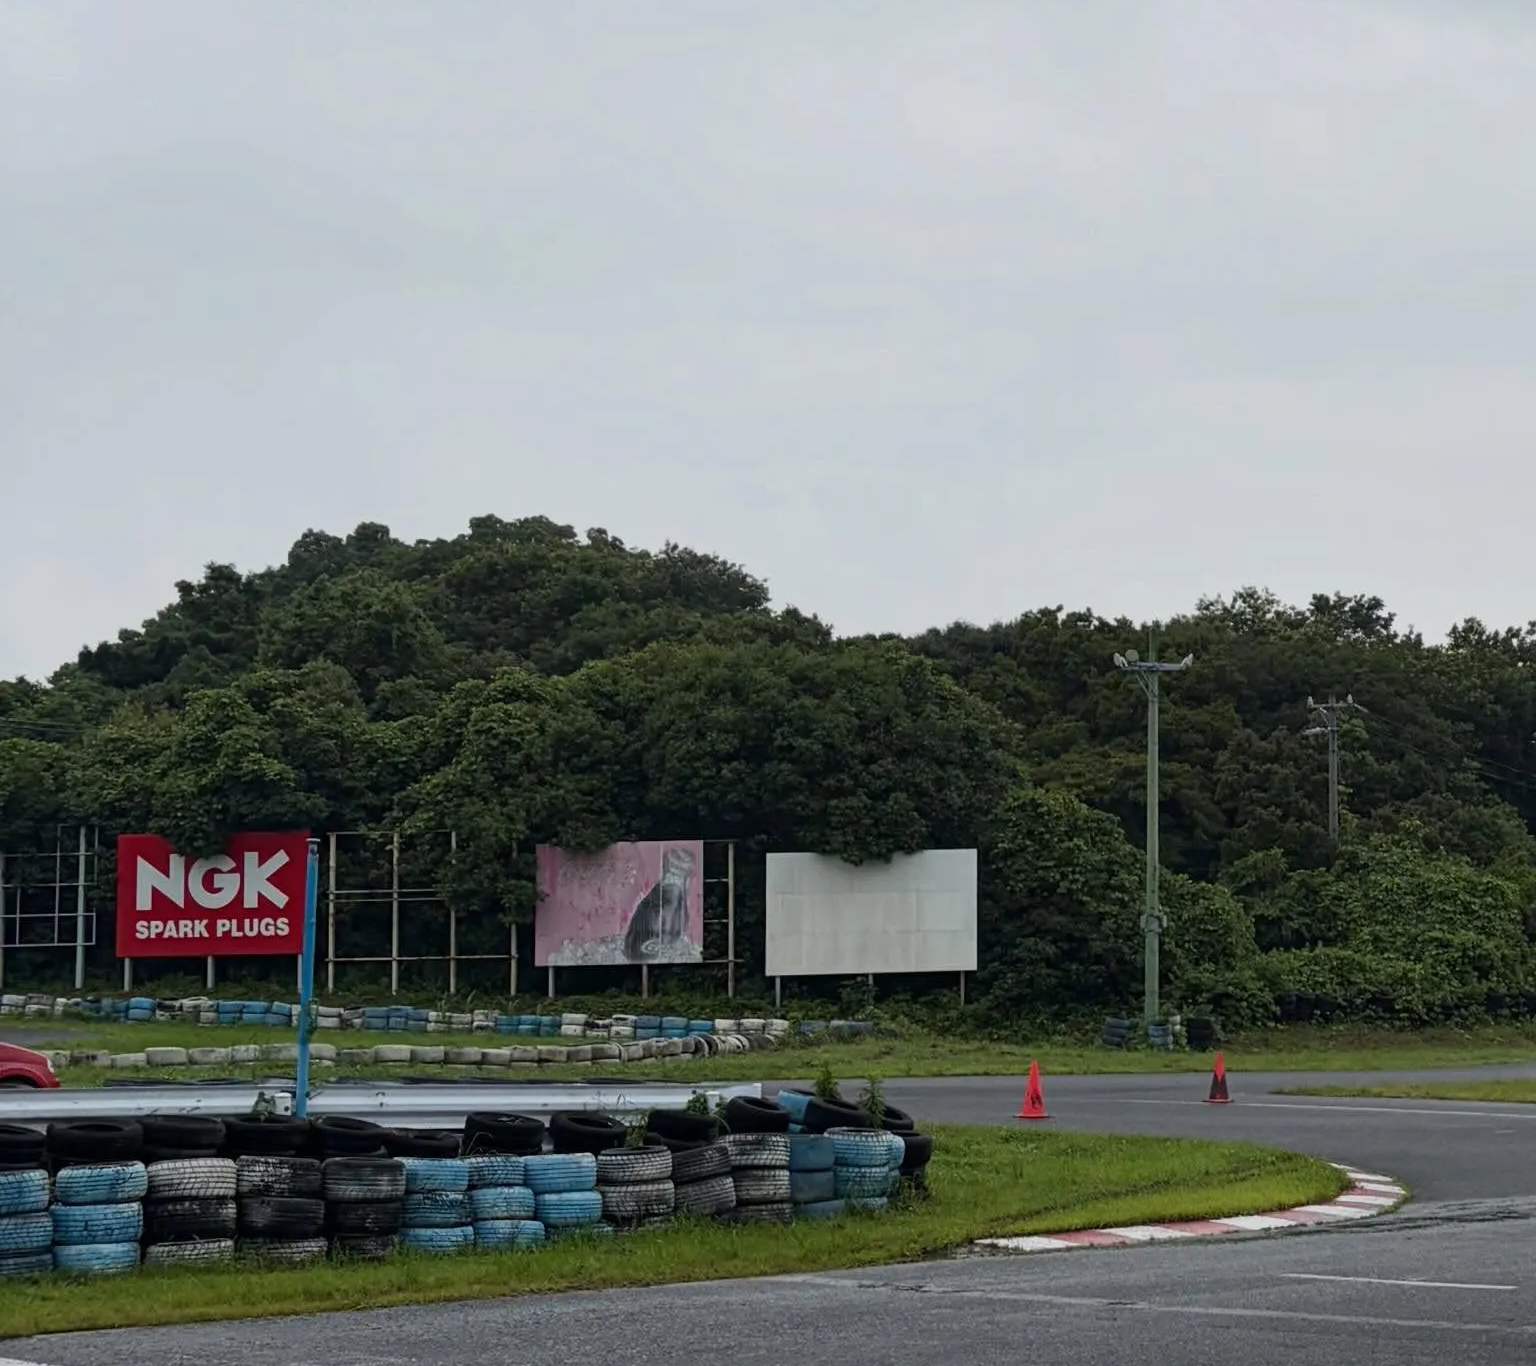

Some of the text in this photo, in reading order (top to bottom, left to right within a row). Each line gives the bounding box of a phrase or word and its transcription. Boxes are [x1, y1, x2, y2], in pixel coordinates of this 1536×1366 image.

[136, 849, 290, 911] NGK
[136, 917, 290, 939] SPARK PLUGS
